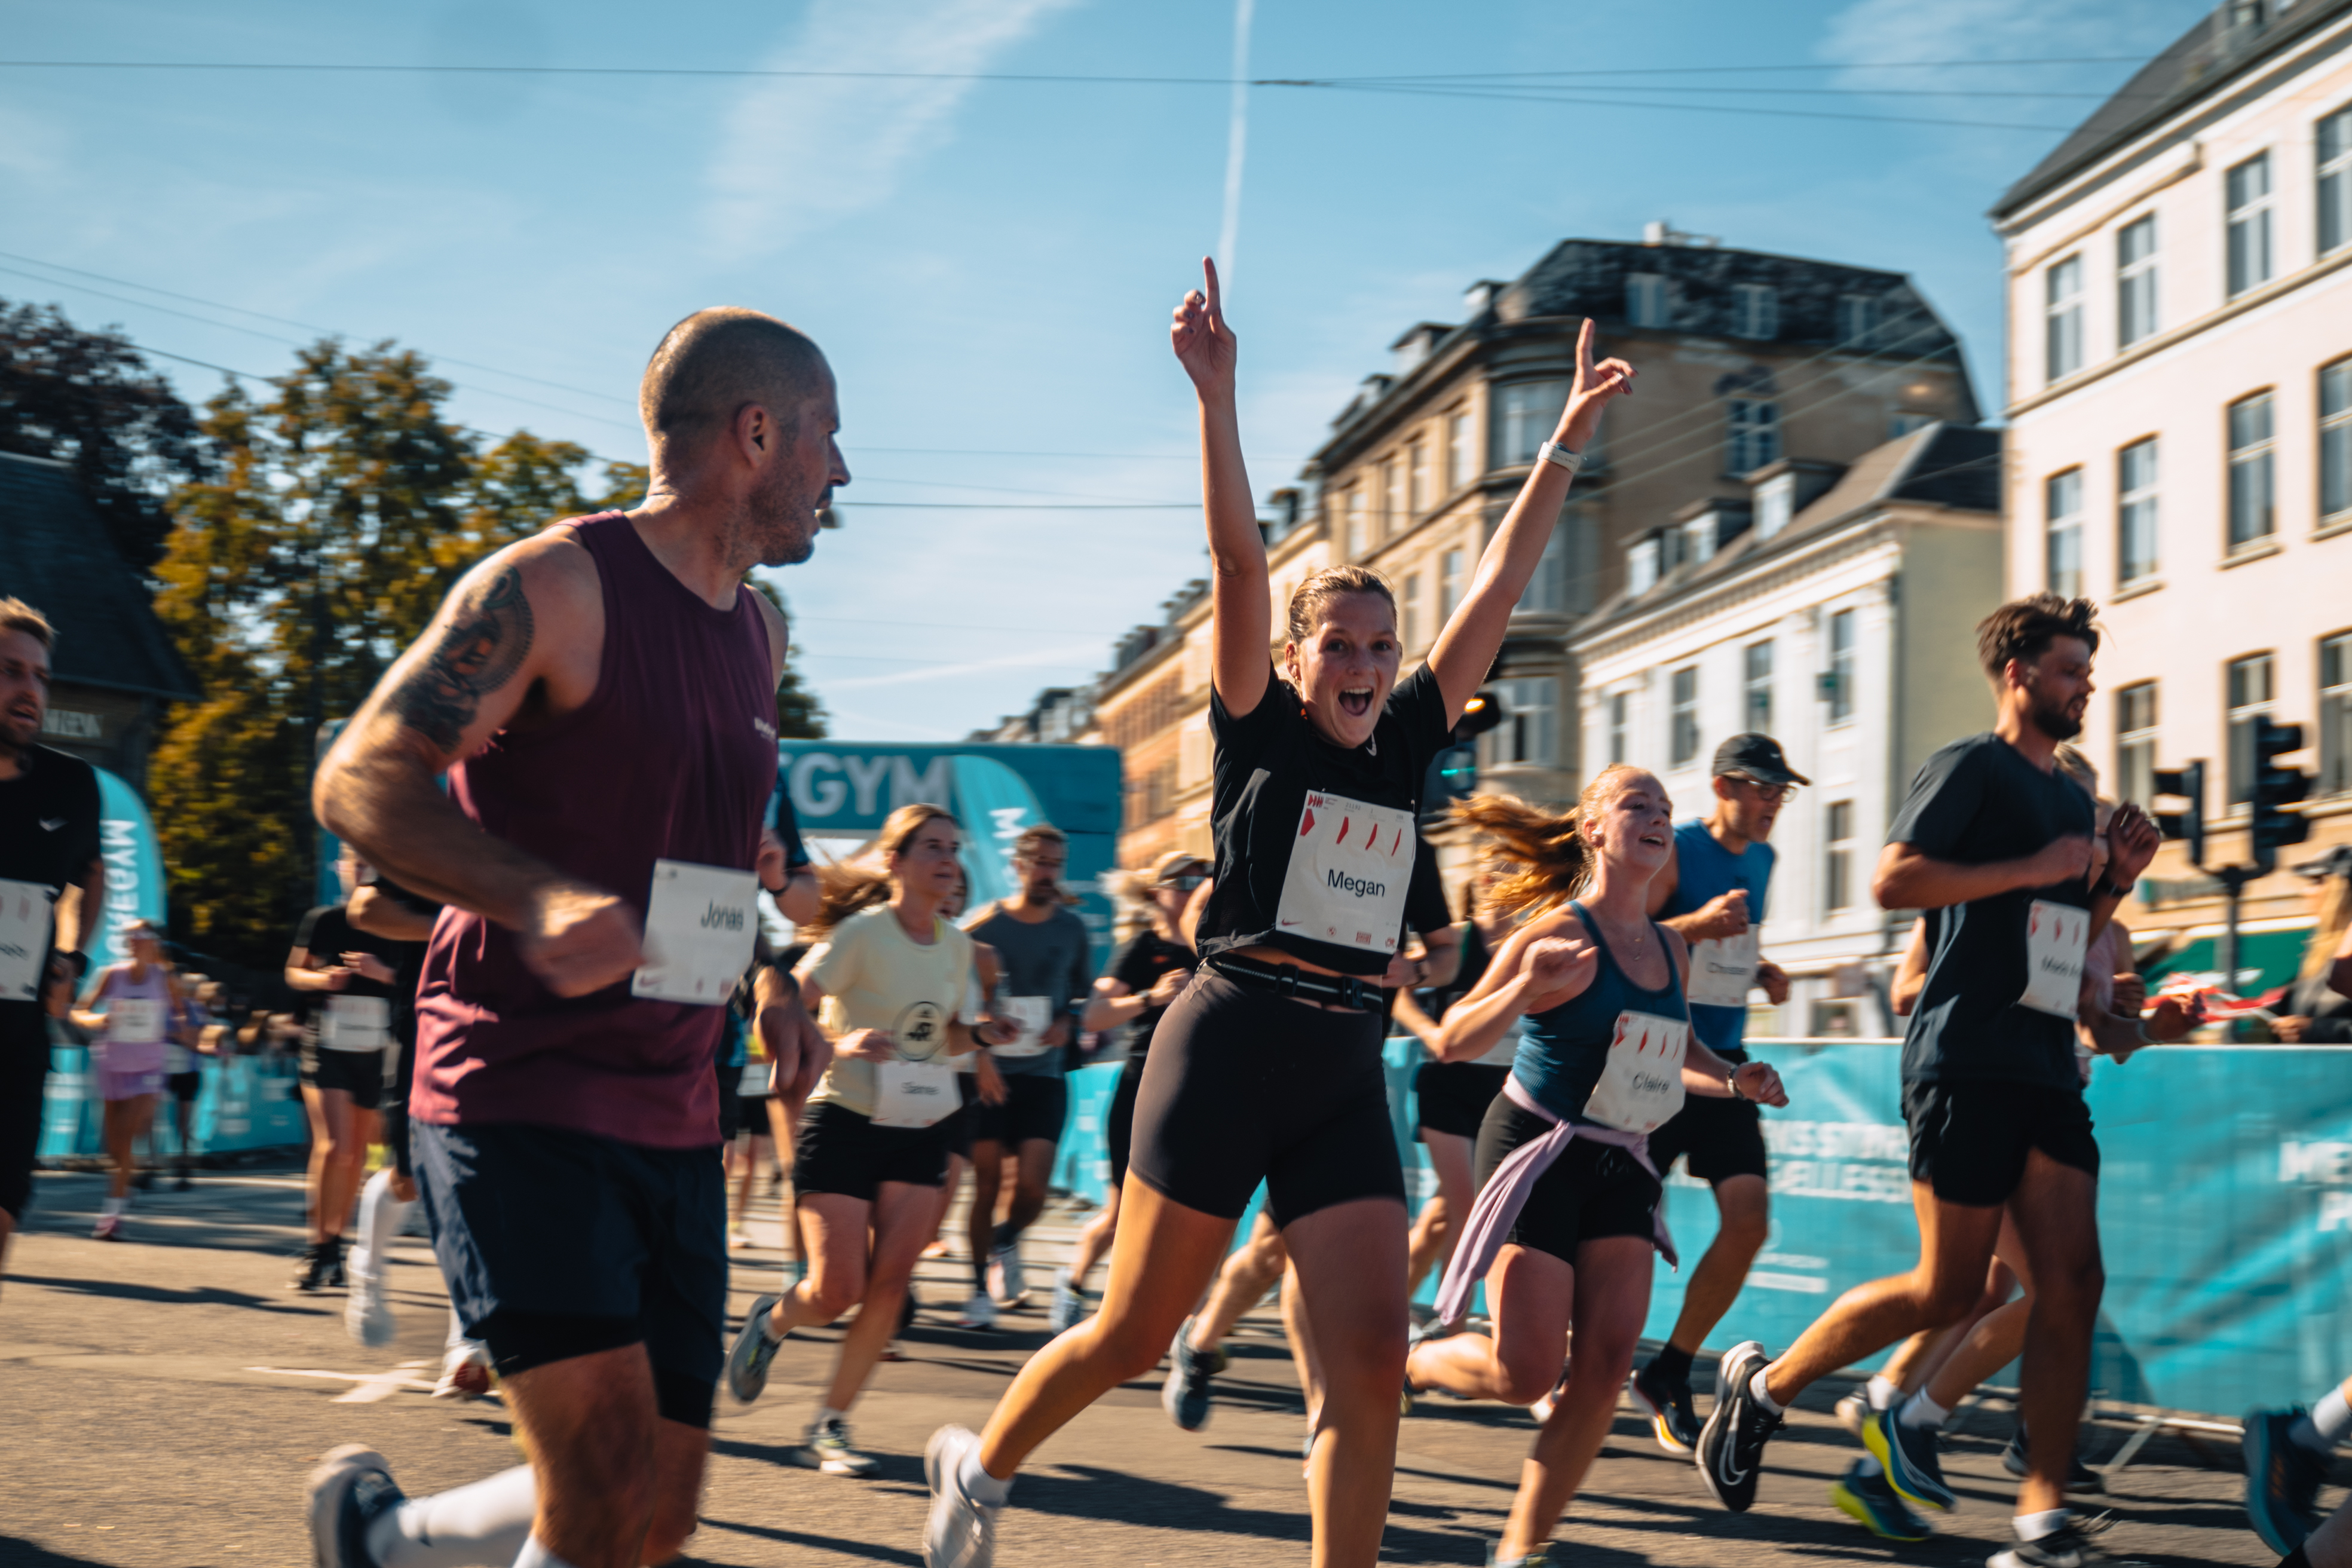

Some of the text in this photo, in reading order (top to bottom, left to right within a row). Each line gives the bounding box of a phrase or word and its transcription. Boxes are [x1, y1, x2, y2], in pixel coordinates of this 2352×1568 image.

[779, 752, 951, 816] GYM
[1327, 868, 1385, 898] Megan
[700, 898, 744, 932] Jonas
[1632, 1070, 1671, 1095] Claire
